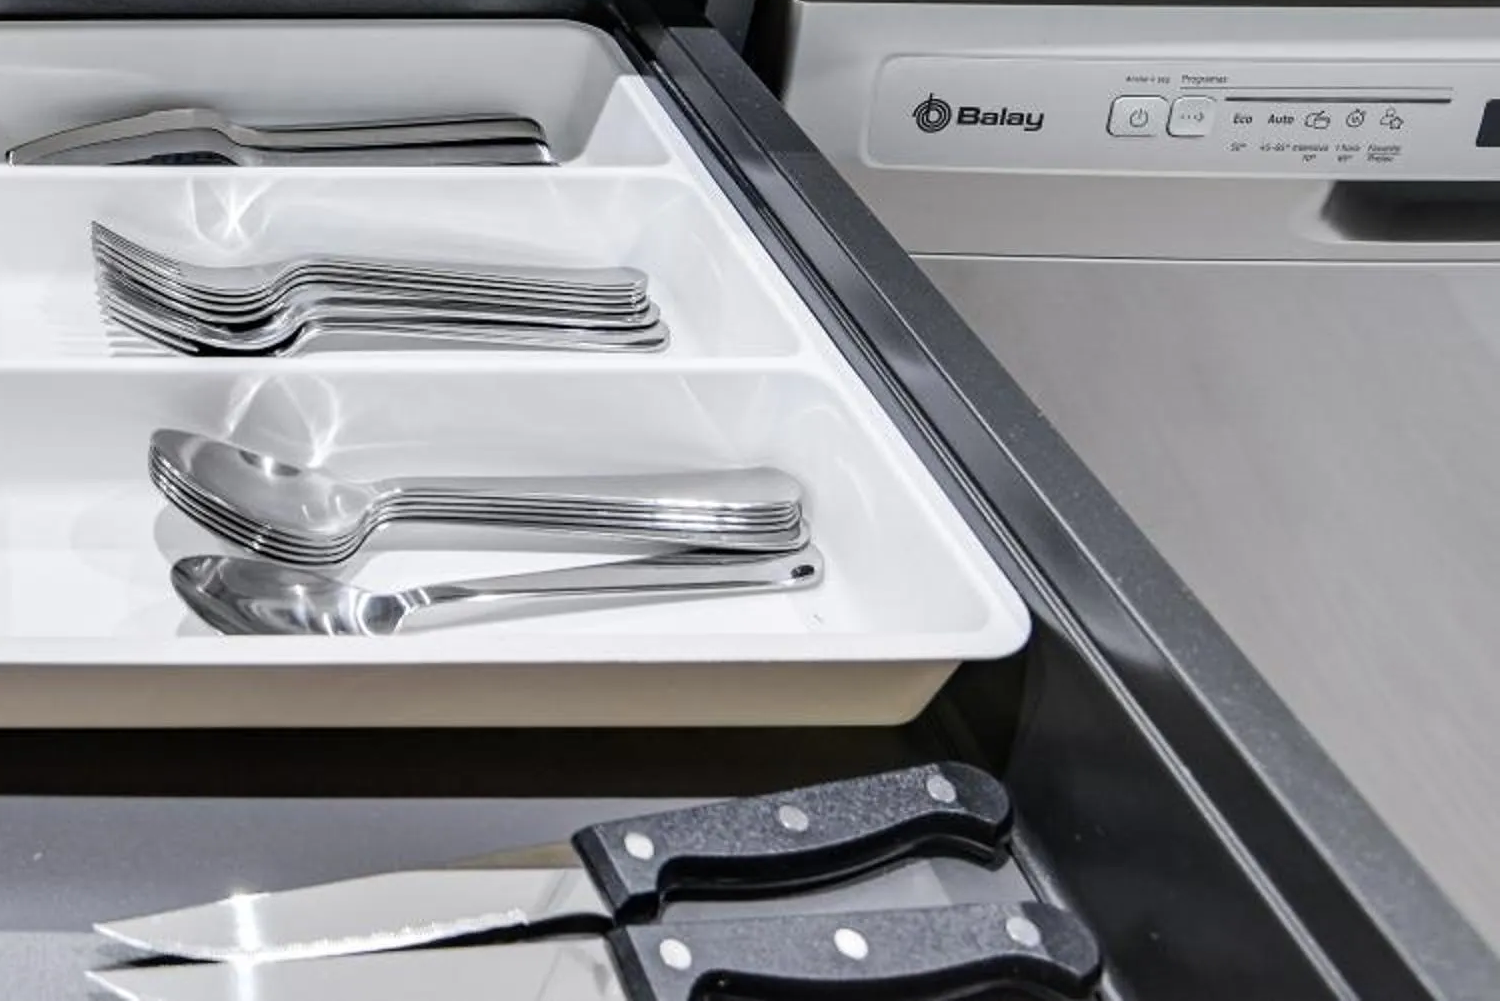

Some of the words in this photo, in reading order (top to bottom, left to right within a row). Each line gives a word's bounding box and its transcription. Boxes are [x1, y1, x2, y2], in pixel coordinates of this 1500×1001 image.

[956, 106, 1044, 131] Balay
[1233, 112, 1253, 124] Eco
[1267, 113, 1295, 124] Auto
